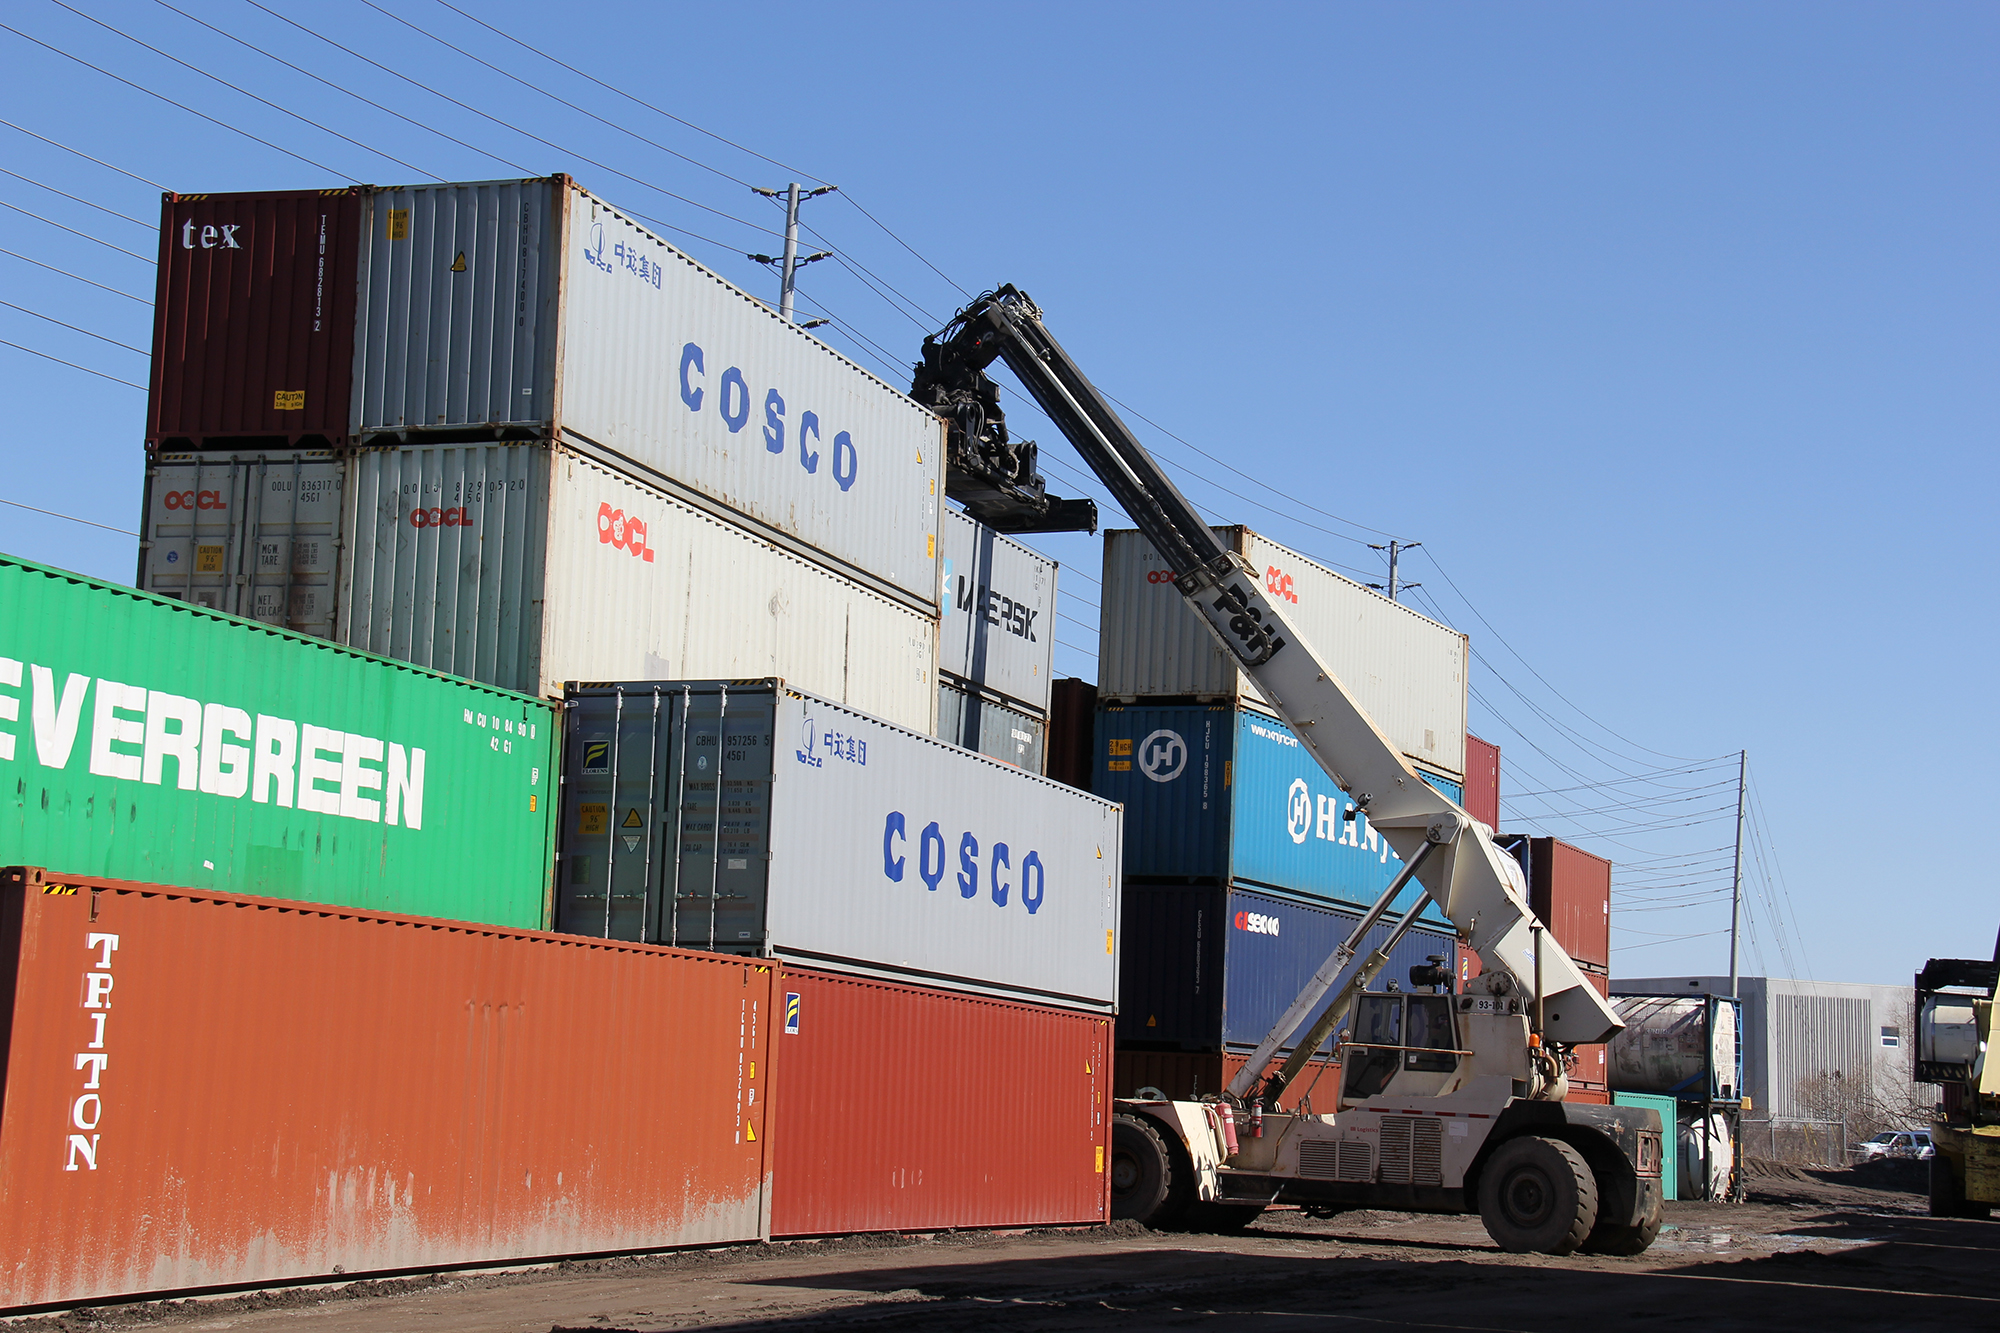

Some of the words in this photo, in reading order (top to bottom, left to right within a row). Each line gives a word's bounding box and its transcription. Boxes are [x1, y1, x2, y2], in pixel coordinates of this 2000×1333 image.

[183, 218, 241, 249] tex
[522, 202, 530, 246] CBHU
[315, 257, 324, 317] 682813
[314, 321, 321, 332] 2
[519, 317, 525, 327] 0
[680, 342, 857, 492] COSCO
[271, 481, 292, 492] OOLU
[301, 480, 332, 491] 836317
[335, 480, 341, 490] 0
[164, 490, 227, 510] OOCL
[301, 492, 321, 503] 45G1
[410, 506, 473, 528] OOCL
[597, 501, 654, 563] OOCL
[199, 546, 222, 554] CAUTION
[203, 563, 216, 571] HIGH
[1147, 570, 1178, 585] OOC
[1265, 565, 1298, 604] OOCL
[957, 575, 1038, 643] MAERSK
[696, 736, 717, 747] CBHU
[727, 735, 757, 746] 957256
[764, 734, 770, 747] 5
[726, 751, 746, 761] 45G1
[581, 805, 606, 813] CAUTION
[585, 824, 600, 832] HIGH
[1316, 793, 1400, 864] HANJ
[883, 810, 1044, 915] COSCO
[65, 932, 119, 1171] TRITON
